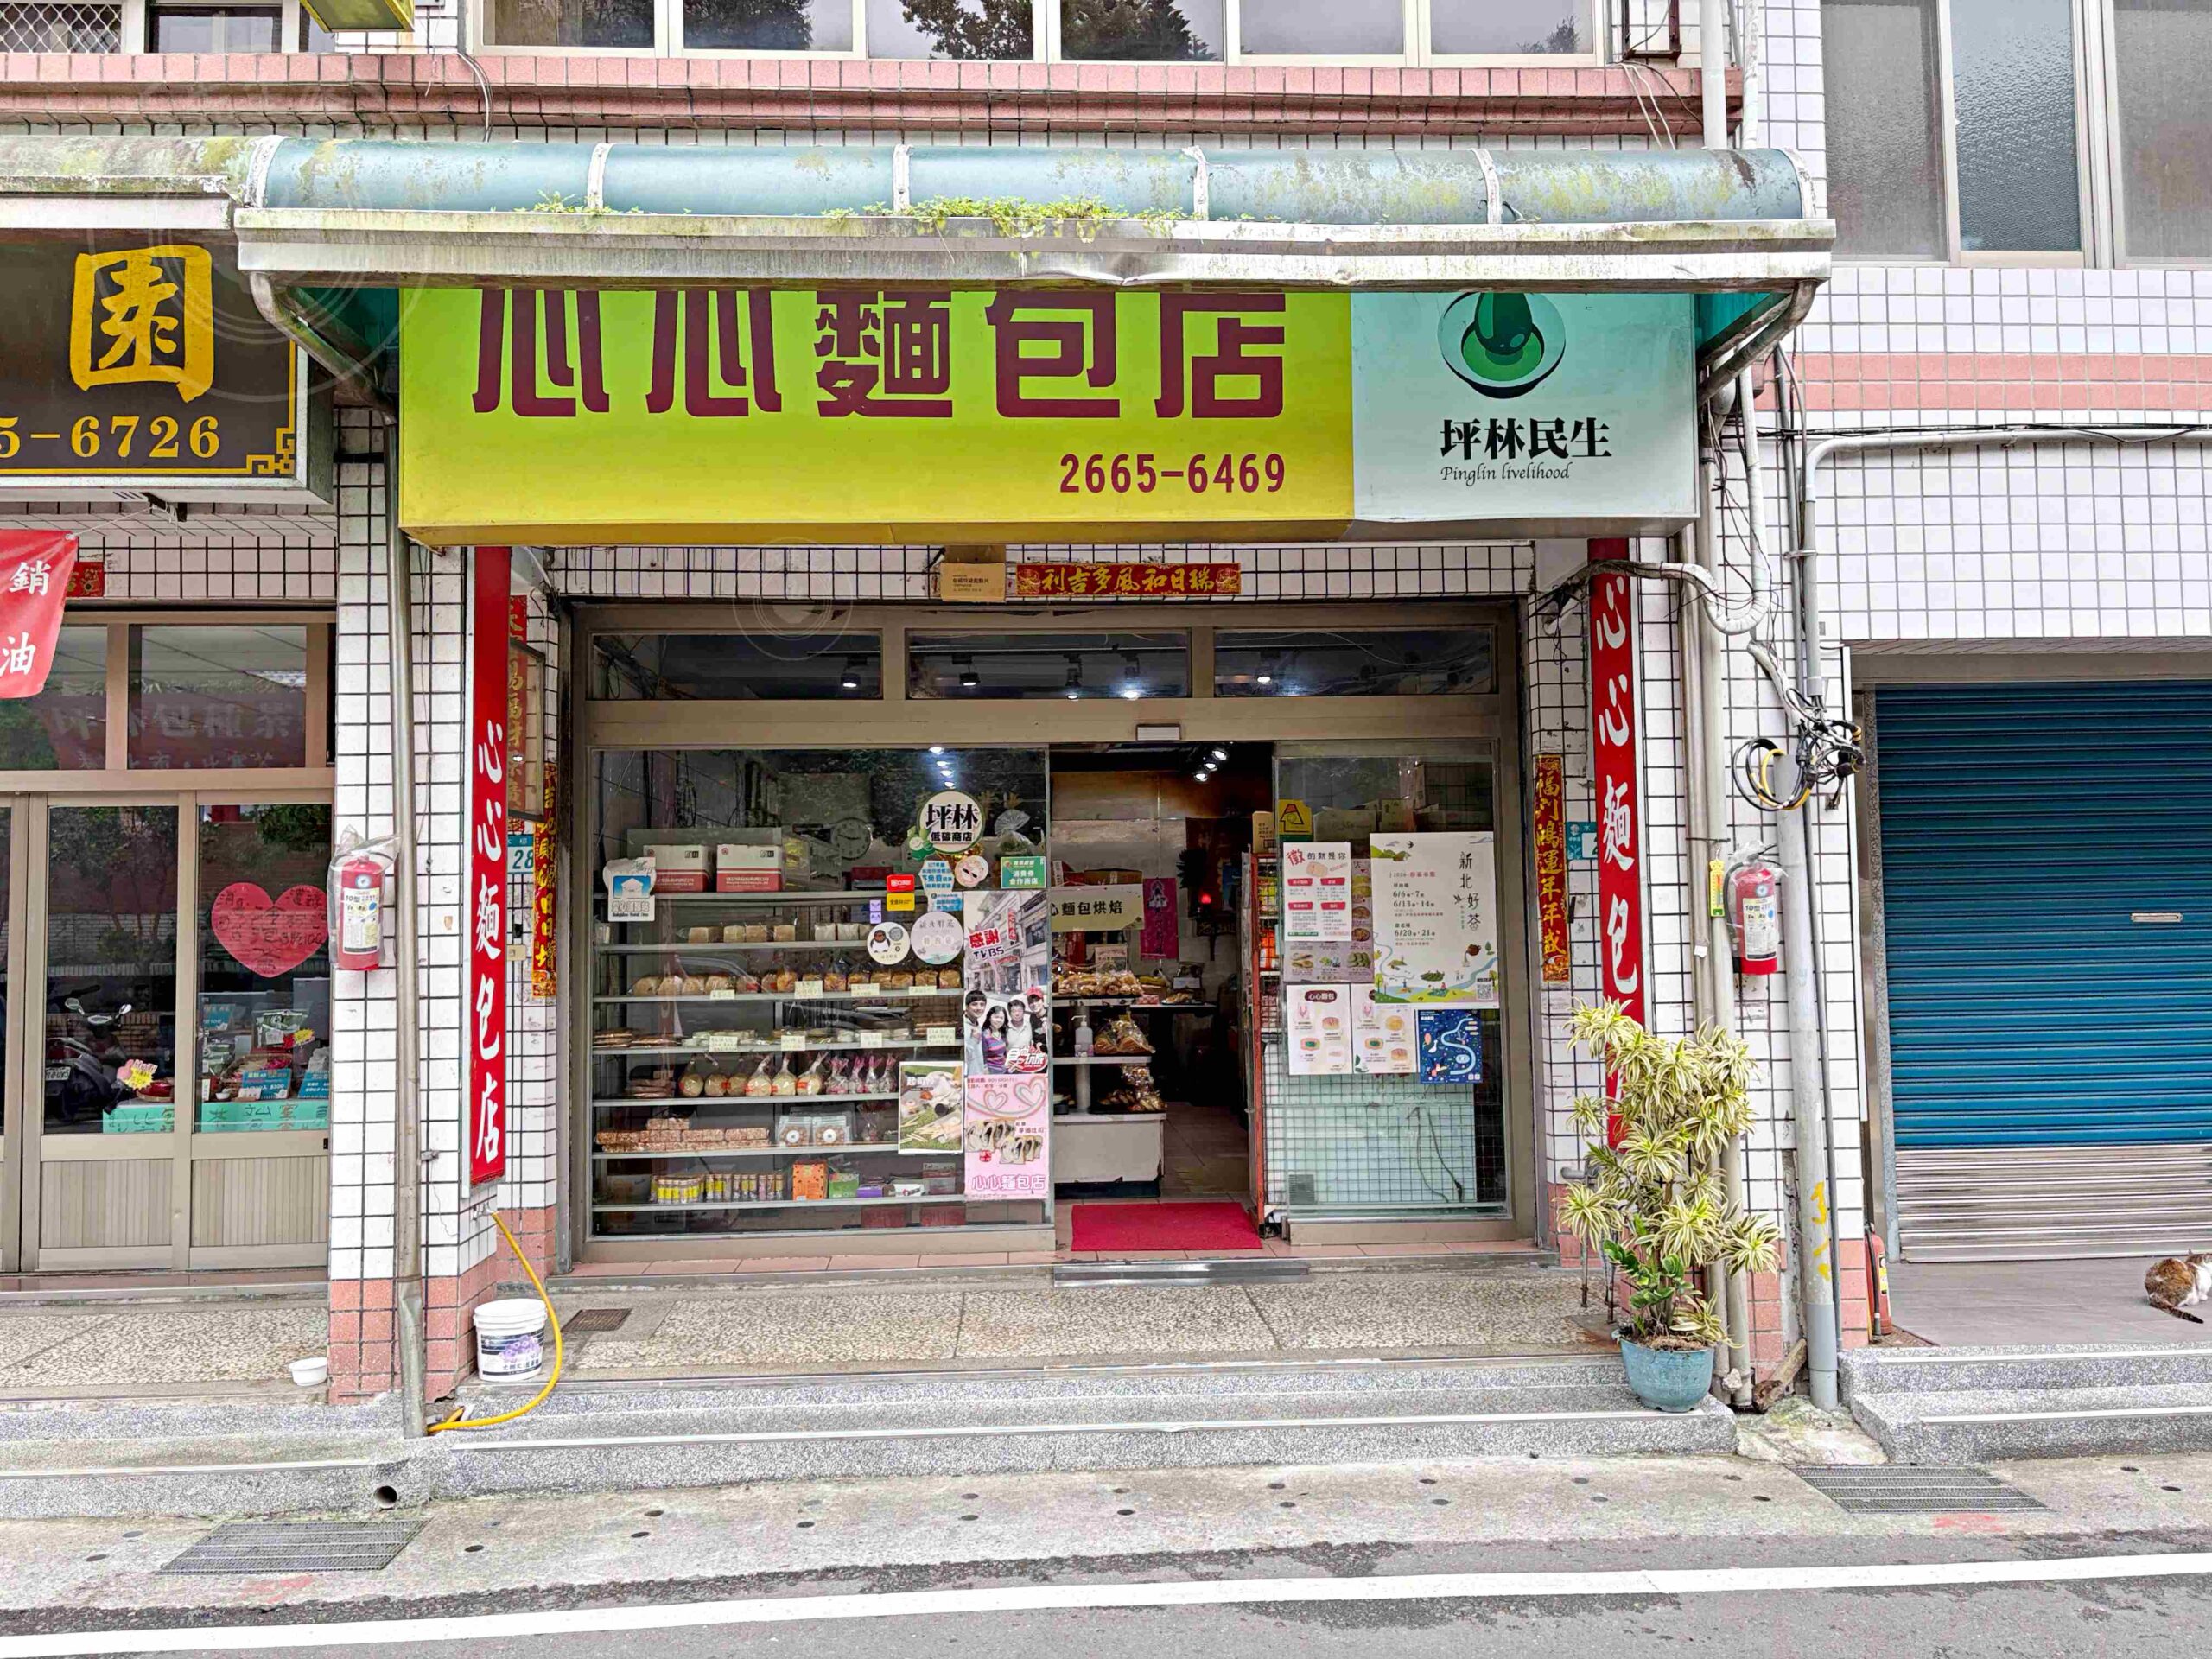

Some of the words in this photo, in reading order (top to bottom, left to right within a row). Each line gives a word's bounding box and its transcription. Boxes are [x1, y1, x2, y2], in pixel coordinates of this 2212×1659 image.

[472, 289, 1286, 419] 心心麵包店
[1440, 417, 1612, 461] 坪林民生
[1058, 453, 1286, 493] 2665-6469
[1440, 462, 1497, 487] Pinglin
[1501, 461, 1573, 480] livelihood
[9, 560, 51, 596] 銷
[0, 632, 36, 677] 油
[925, 804, 980, 830] 坪林
[930, 831, 973, 842] 低碳商店
[1596, 575, 1638, 1103] 心心麵包
[512, 849, 533, 869] 28
[476, 719, 503, 1164] 心心麵包店
[969, 928, 1000, 949] 感謝
[973, 946, 1005, 961] TVBS
[971, 1173, 1047, 1192] 心心麵包店
